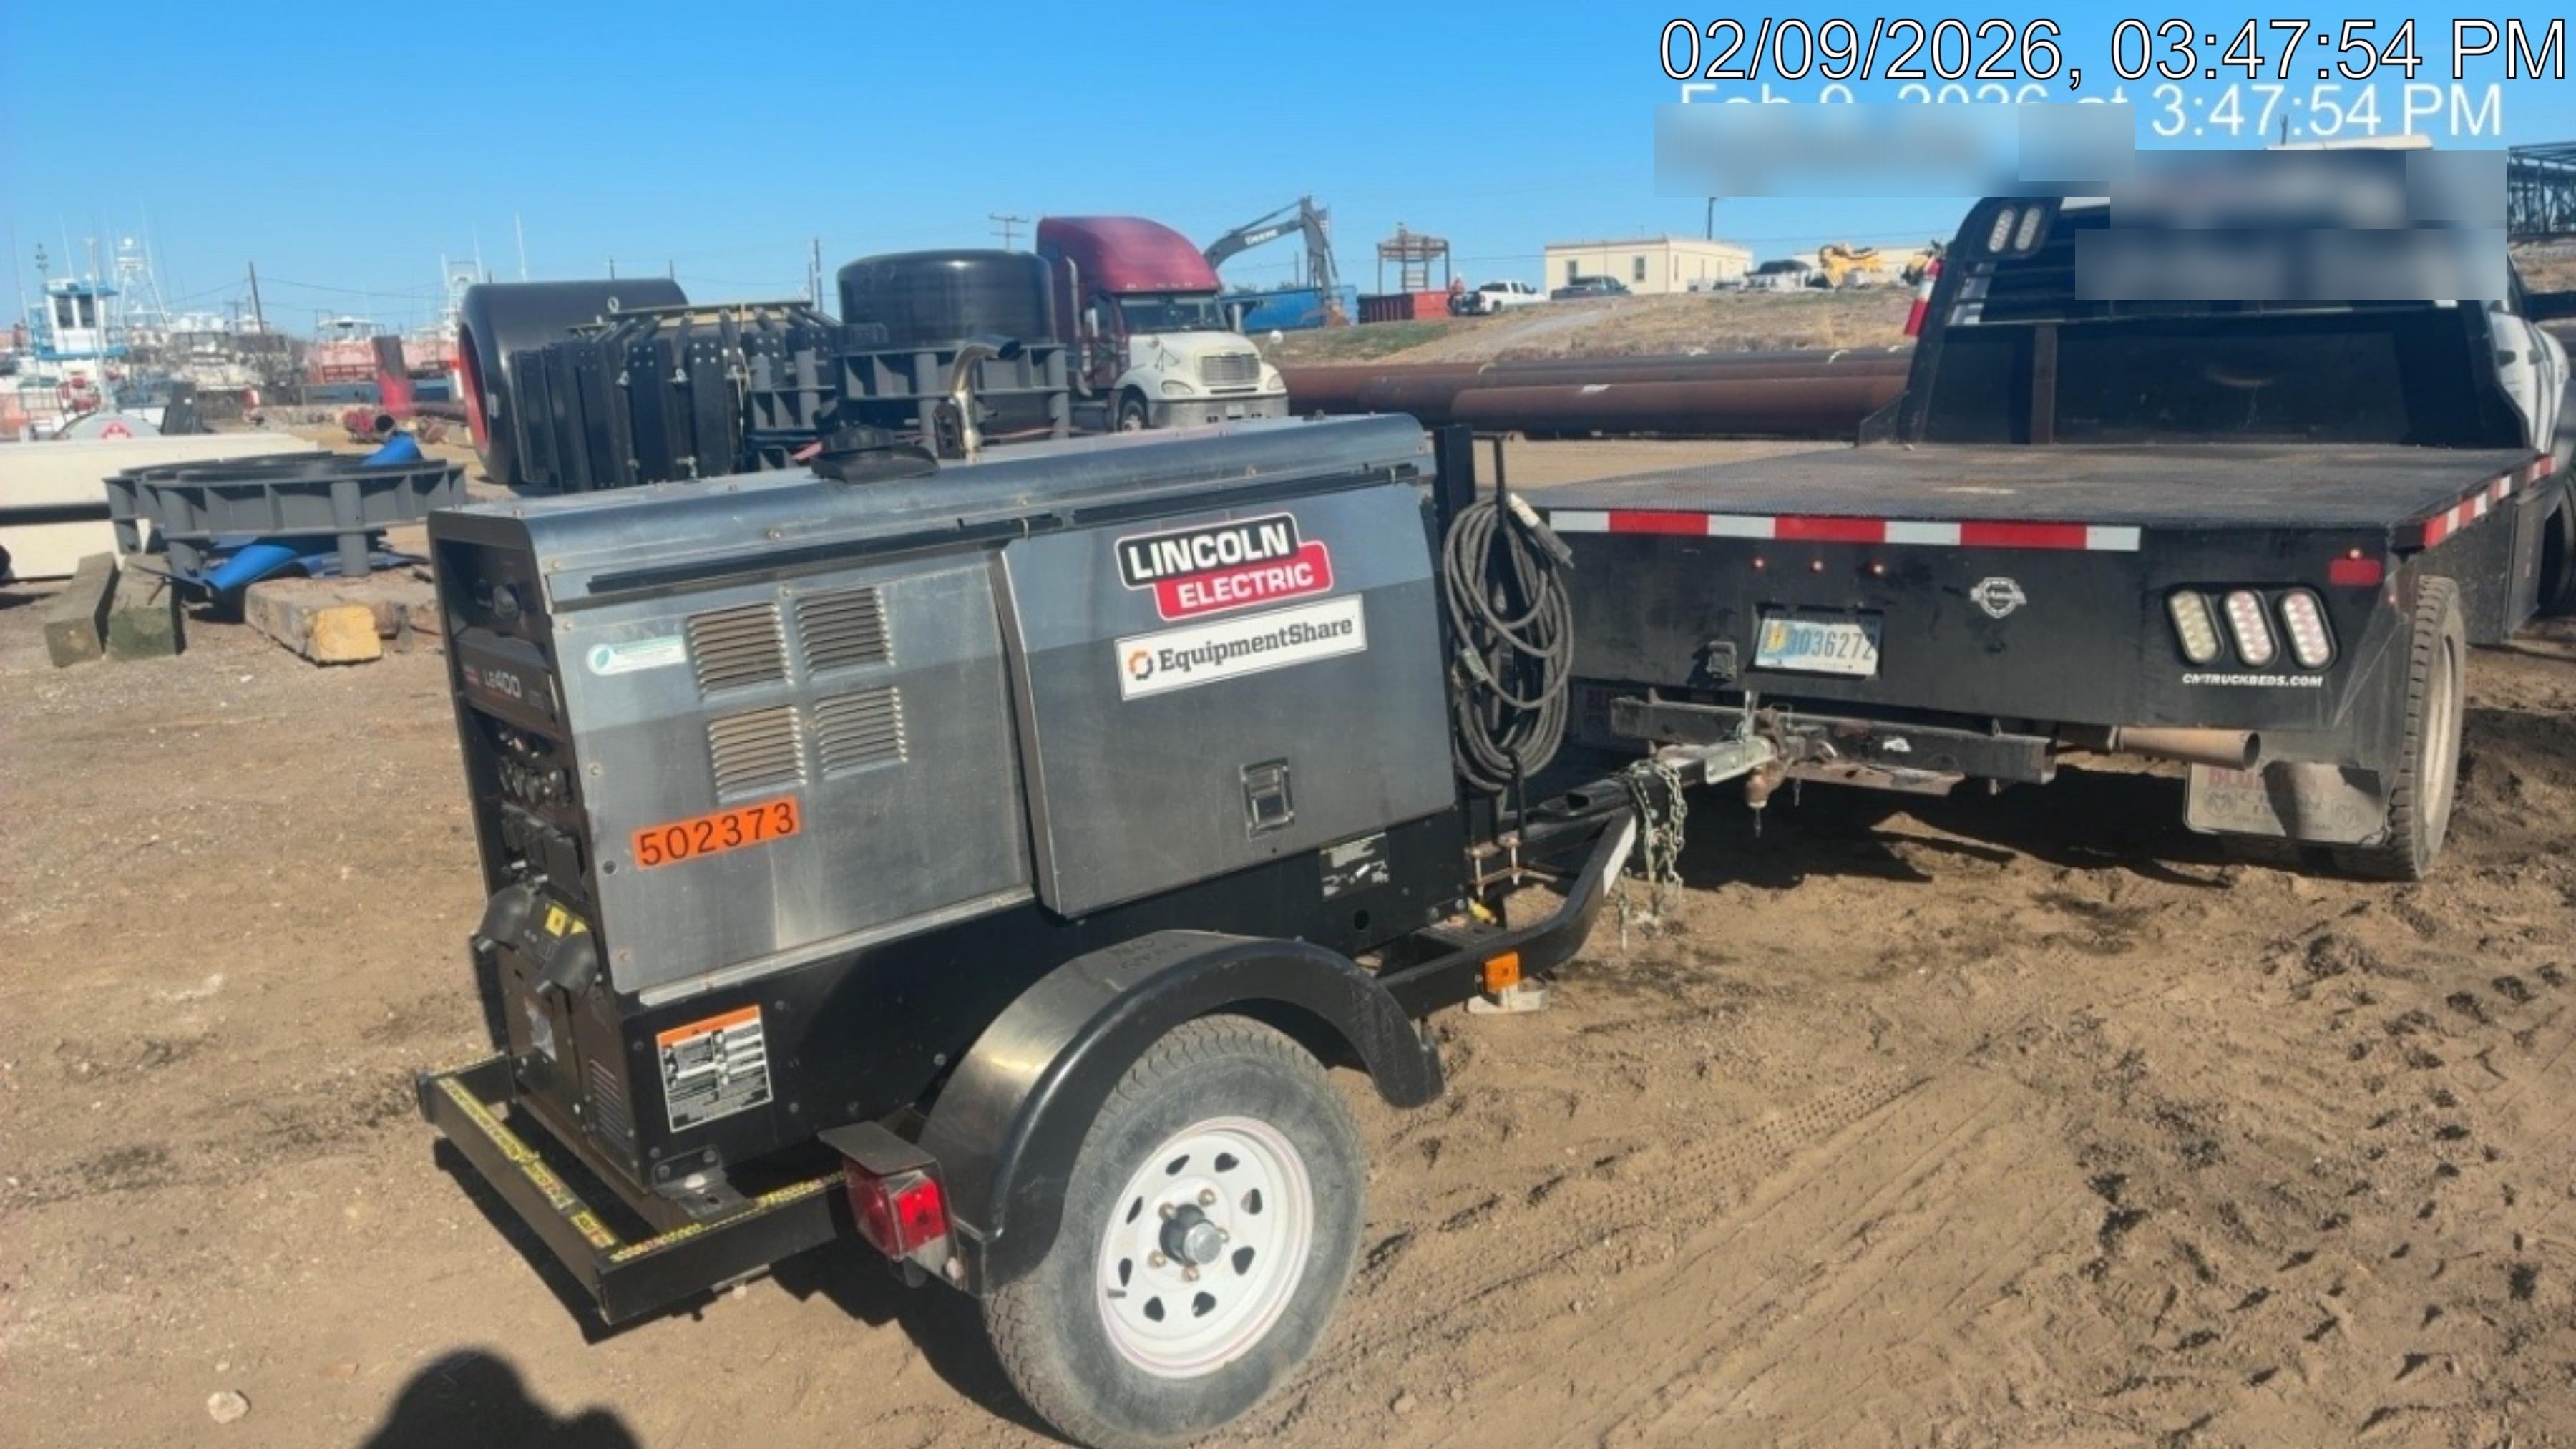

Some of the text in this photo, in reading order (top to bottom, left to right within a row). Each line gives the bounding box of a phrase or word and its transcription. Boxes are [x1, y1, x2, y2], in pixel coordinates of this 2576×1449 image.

[1128, 522, 1291, 580] LINCOLN
[1177, 562, 1314, 609] ELECTRIC
[1158, 618, 1353, 673] EquipmentShare
[639, 801, 796, 867] 502373
